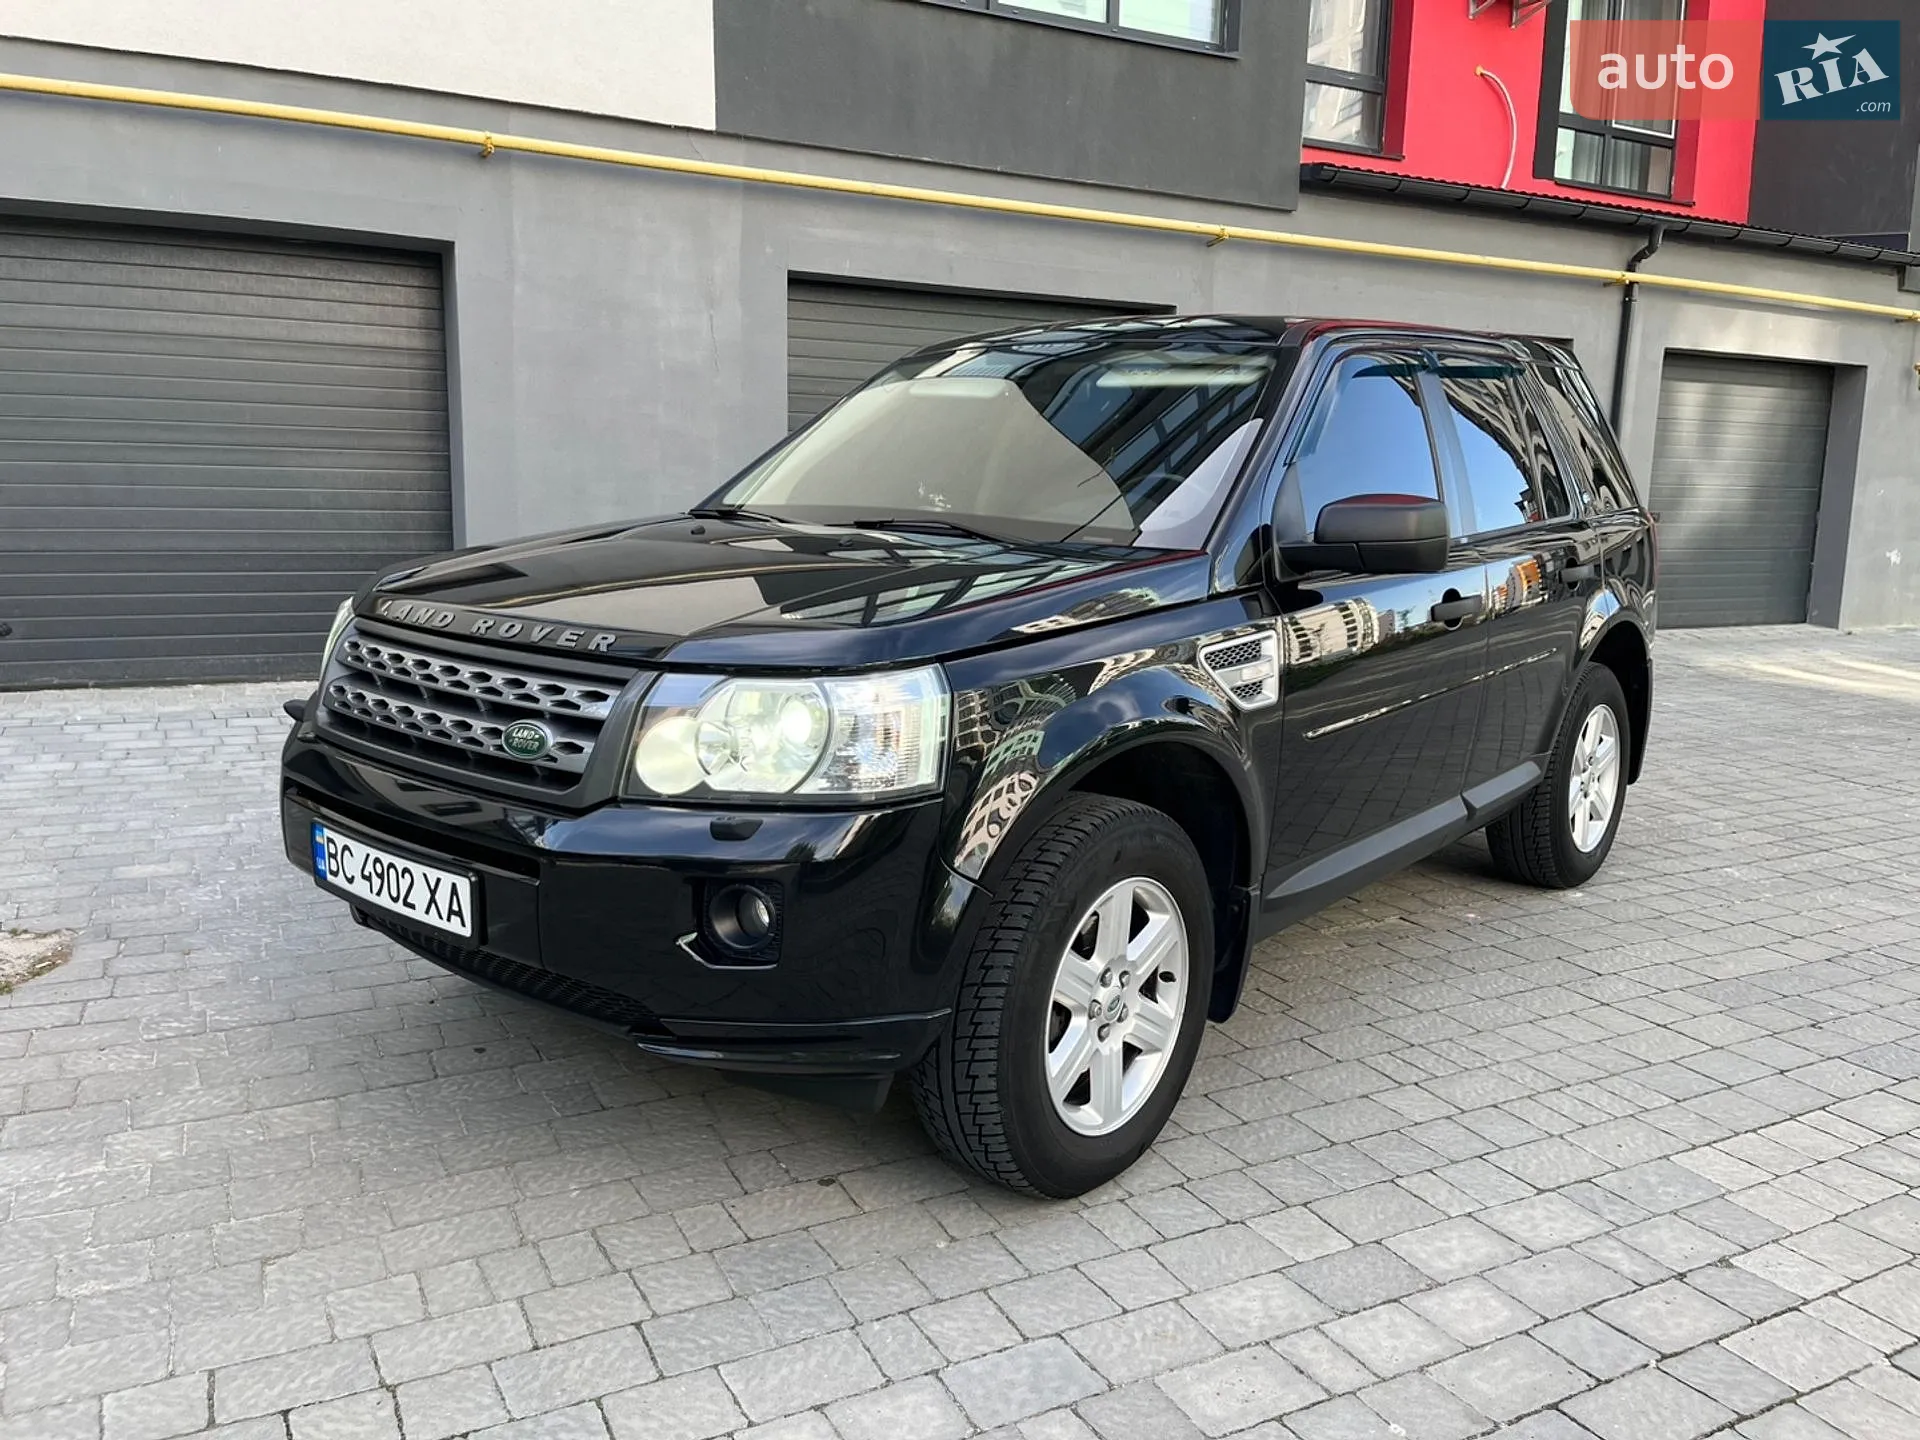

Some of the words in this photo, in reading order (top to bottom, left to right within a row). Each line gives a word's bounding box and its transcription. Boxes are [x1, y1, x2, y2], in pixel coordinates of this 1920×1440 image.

[378, 600, 455, 629] LAND
[470, 618, 616, 652] ROVER
[326, 837, 355, 885] BC
[360, 853, 416, 911] 4902
[422, 872, 466, 928] XA
